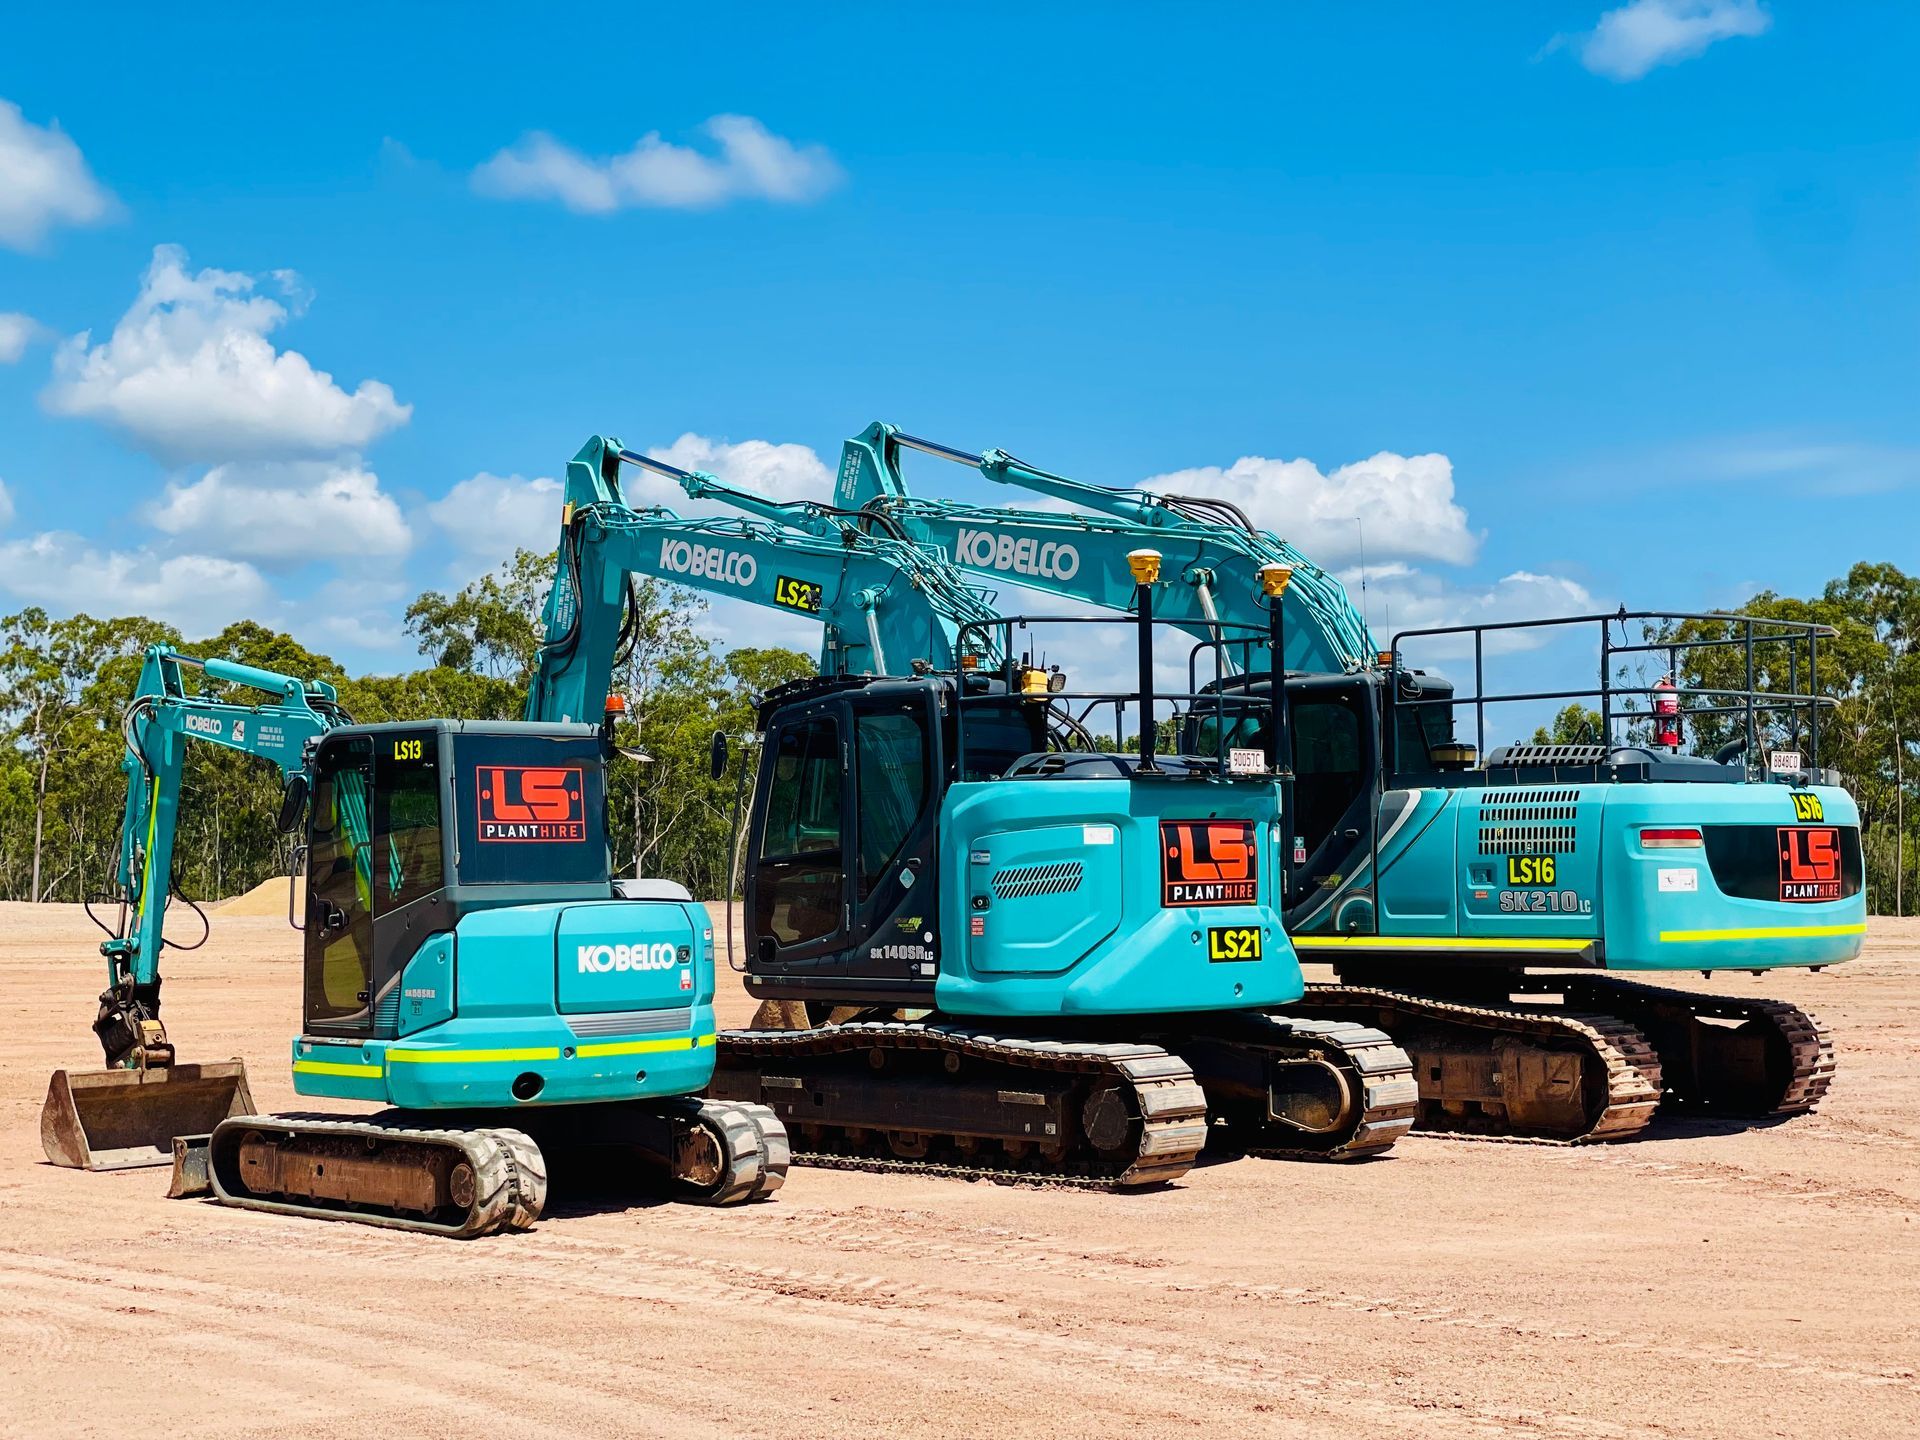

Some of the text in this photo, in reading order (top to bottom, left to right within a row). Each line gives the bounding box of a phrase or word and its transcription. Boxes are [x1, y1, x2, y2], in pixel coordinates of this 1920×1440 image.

[659, 537, 757, 587] KOBELCO
[955, 527, 1080, 581] KOBELCO
[186, 714, 222, 735] KOBELCO
[394, 740, 421, 760] LS13
[1234, 752, 1260, 767] 90057C
[491, 770, 570, 820] LS
[1792, 794, 1823, 820] LS16
[1177, 825, 1248, 880] LS
[1788, 831, 1835, 880] LS
[1509, 857, 1555, 883] LS16
[578, 943, 676, 974] KOBELCO
[1211, 929, 1260, 960] LS21
